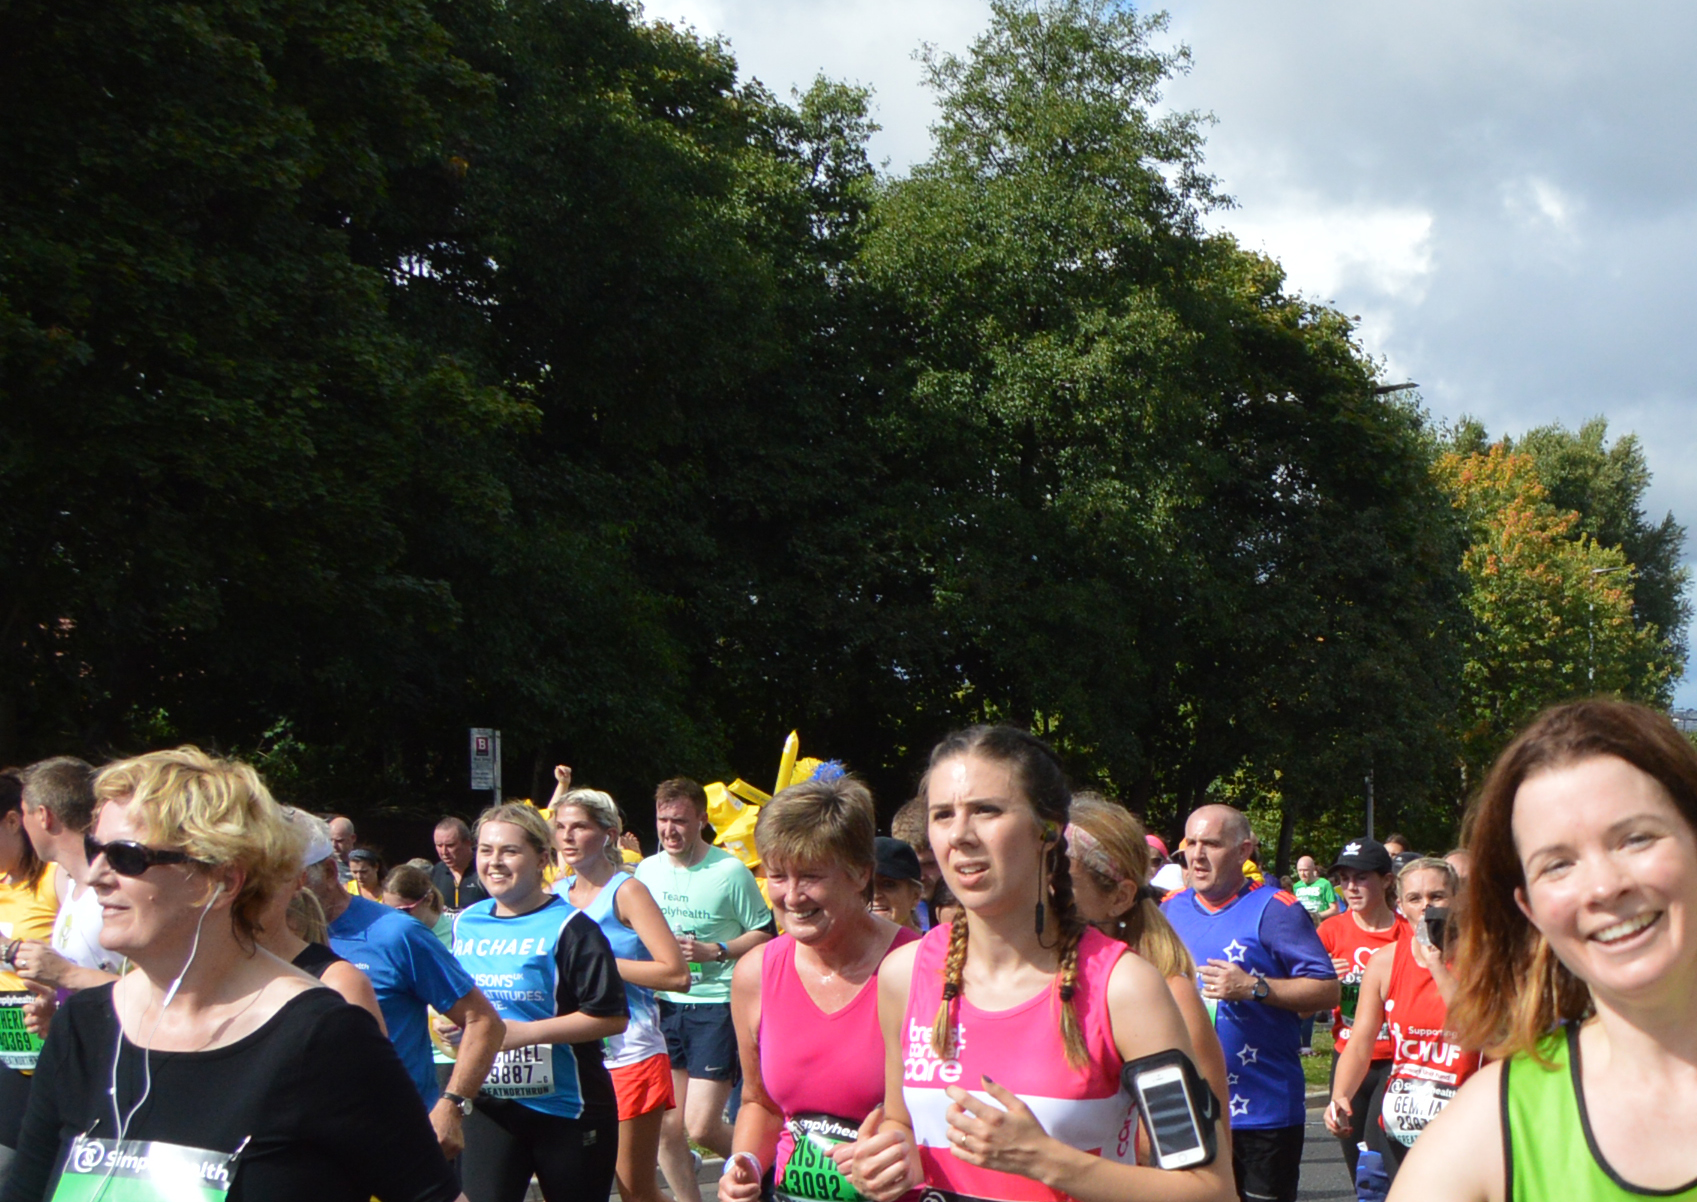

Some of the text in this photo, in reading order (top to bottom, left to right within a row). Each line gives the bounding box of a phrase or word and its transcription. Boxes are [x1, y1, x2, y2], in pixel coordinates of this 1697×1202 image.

[662, 891, 689, 903] Team
[661, 906, 711, 920] plyhealth
[0, 1031, 32, 1052] 0369
[483, 1065, 533, 1085] 9887
[780, 1169, 844, 1201] 3092
